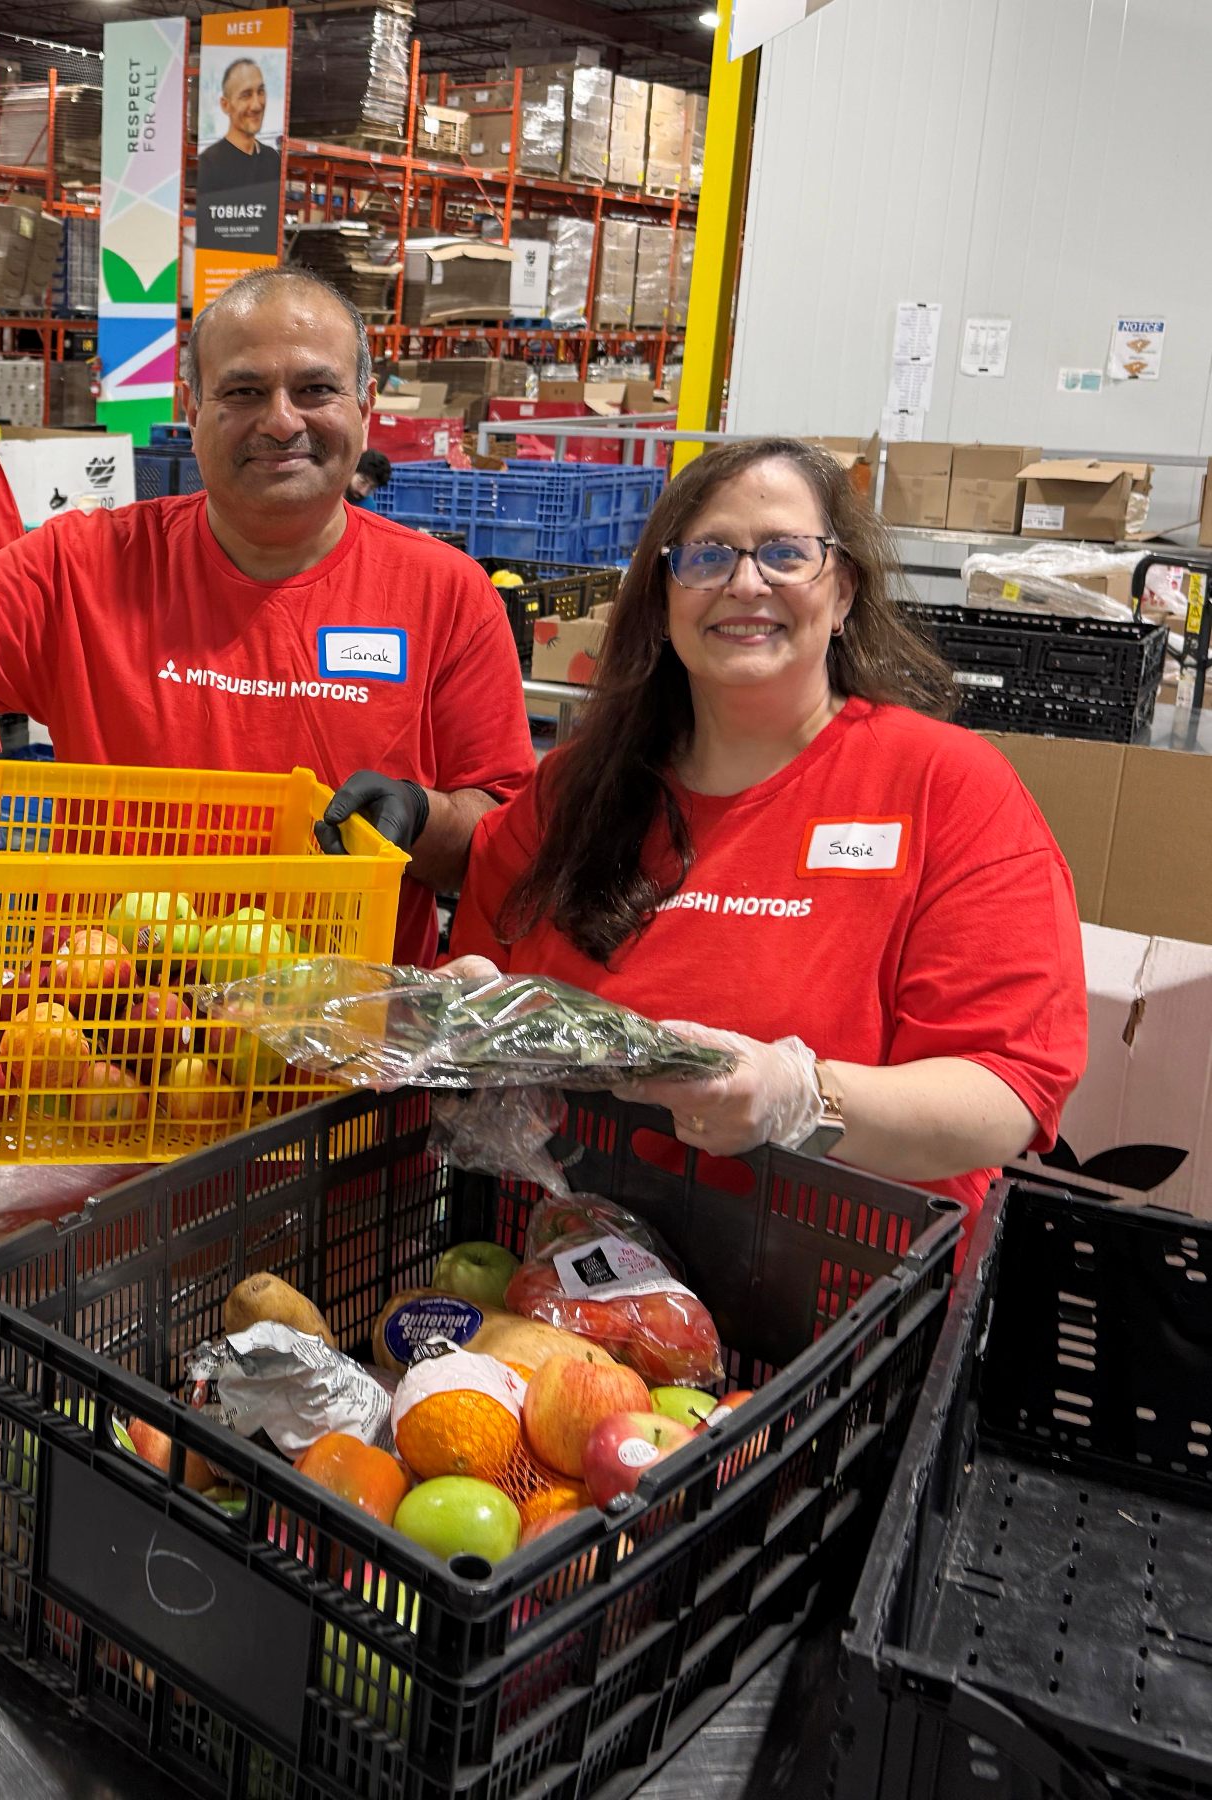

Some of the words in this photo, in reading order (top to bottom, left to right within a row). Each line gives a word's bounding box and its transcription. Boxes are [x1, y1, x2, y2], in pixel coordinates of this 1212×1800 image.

[227, 20, 262, 35] MEET
[144, 65, 157, 104] ALL
[127, 58, 140, 153] RESPECT
[143, 113, 156, 152] FOR
[1124, 321, 1161, 332] NOTICE
[340, 645, 392, 664] Janak
[186, 668, 286, 697] MITSUBISHI
[290, 681, 369, 703] MOTORS
[829, 840, 874, 858] Susie
[722, 896, 813, 917] MOTORS
[398, 1312, 471, 1327] Butternut
[146, 1531, 216, 1615] 6
